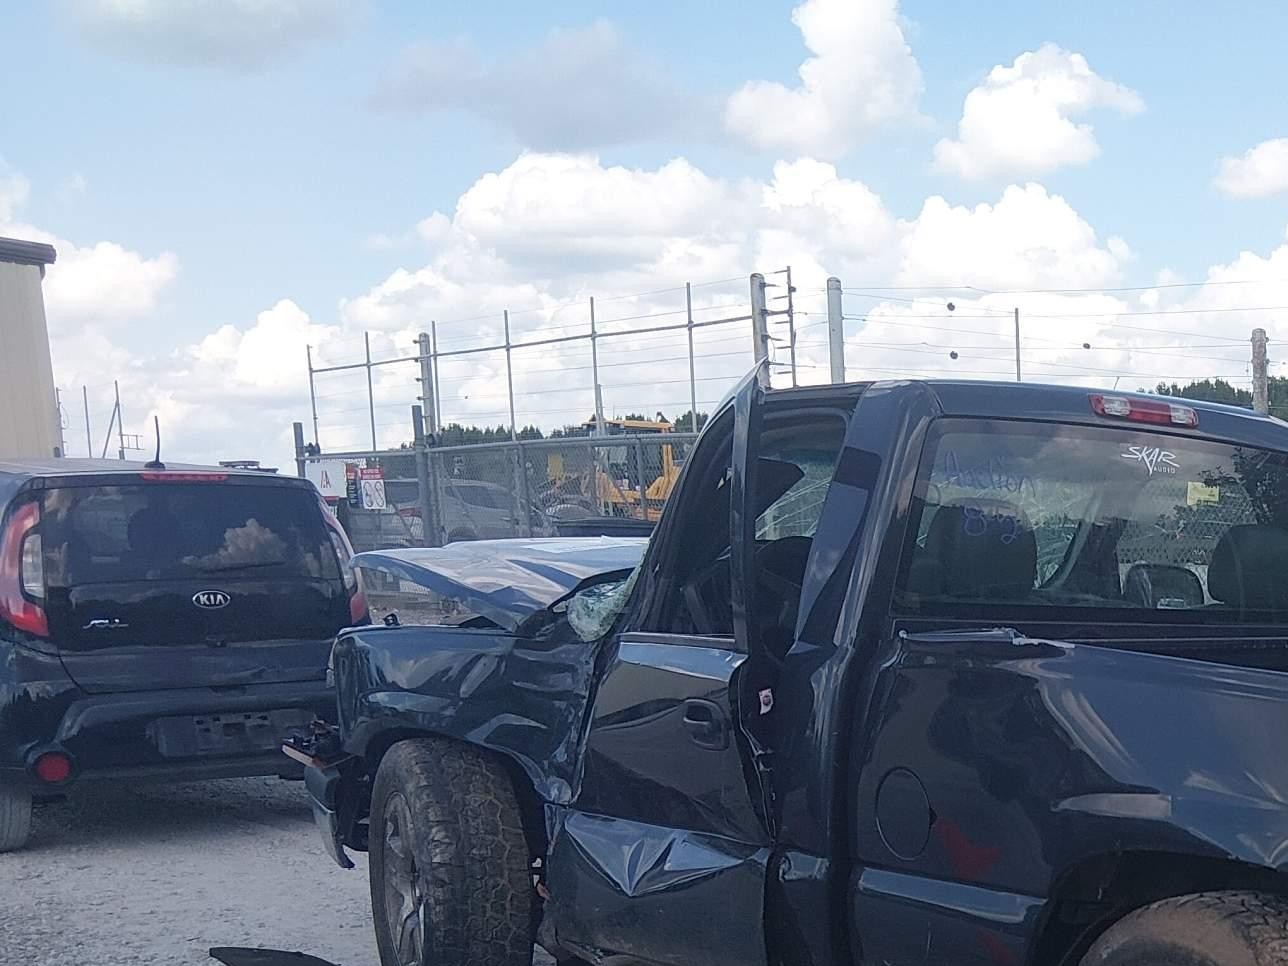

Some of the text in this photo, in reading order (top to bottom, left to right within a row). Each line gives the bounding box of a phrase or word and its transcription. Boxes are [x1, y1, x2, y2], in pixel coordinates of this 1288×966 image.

[1121, 446, 1180, 477] SKAR
[1153, 466, 1177, 474] AUDIO
[197, 592, 227, 606] KIA
